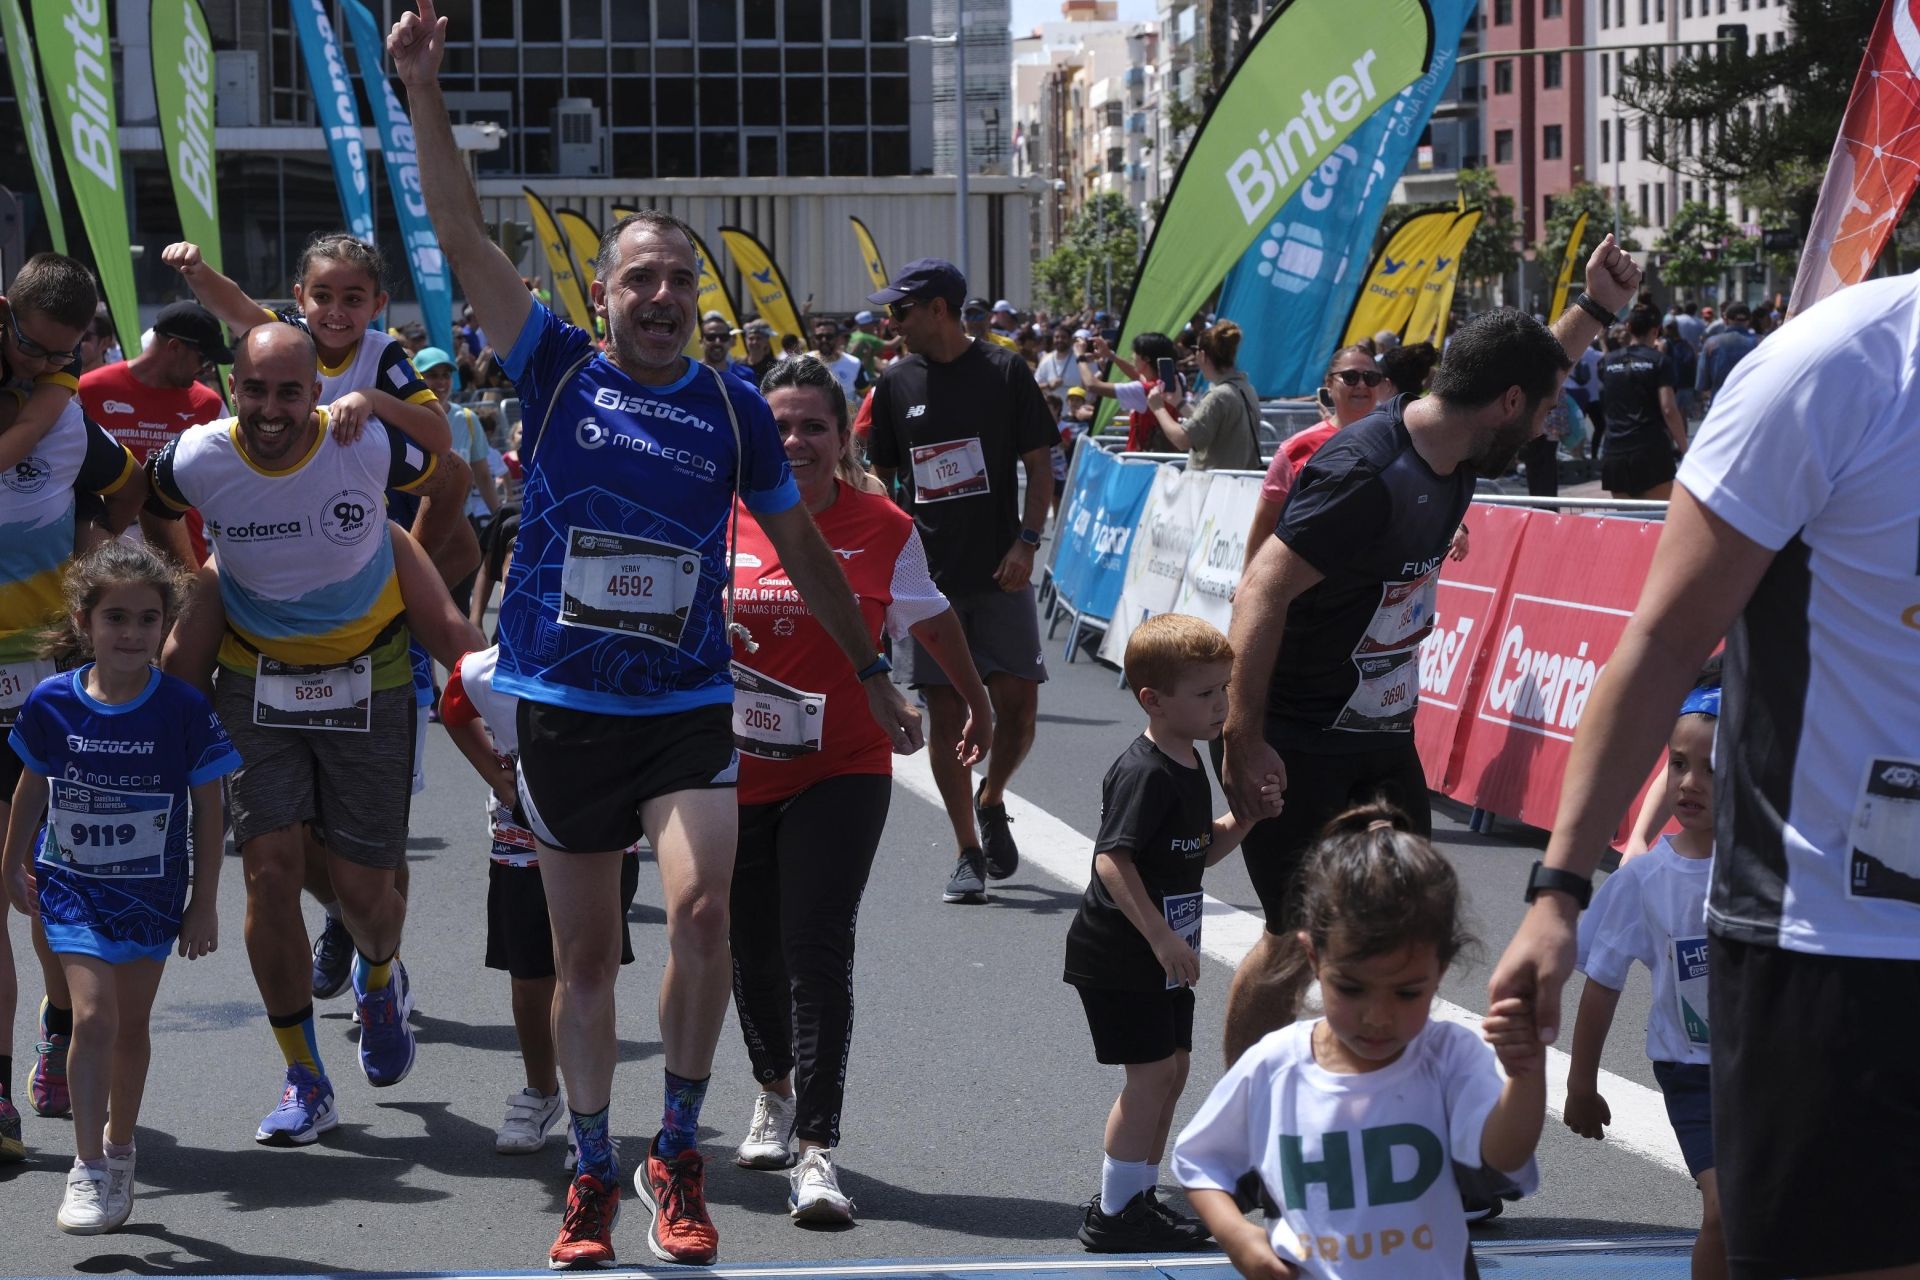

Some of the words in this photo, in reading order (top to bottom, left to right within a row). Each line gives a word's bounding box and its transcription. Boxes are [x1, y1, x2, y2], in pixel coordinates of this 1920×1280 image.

[1396, 98, 1424, 137] CAJA
[1419, 48, 1452, 96] RURAL
[176, 0, 215, 221] Binter
[1225, 48, 1377, 226] Binter
[140, 430, 149, 439] DE
[149, 430, 163, 440] LAS
[612, 433, 717, 477] MOLECOR
[936, 462, 960, 481] 1722
[333, 502, 365, 528] 90
[226, 521, 302, 538] cofarca
[342, 521, 364, 533] años
[621, 565, 641, 573] YERAY
[606, 575, 654, 598] 4592
[760, 588, 775, 602] DE
[776, 589, 799, 603] LAS
[738, 604, 770, 615] PALMAS
[771, 605, 782, 615] DE
[783, 606, 805, 616] GRAN
[1489, 624, 1608, 730] Canaria
[295, 685, 334, 701] 5230
[1380, 682, 1407, 708] 3690
[745, 708, 782, 732] 2052
[86, 772, 161, 787] MOLECOR
[56, 785, 92, 803] HPS
[70, 823, 137, 847] 9119
[1170, 898, 1197, 921] HPS
[1278, 1122, 1444, 1212] HD
[1294, 1222, 1434, 1262] GRUPO
